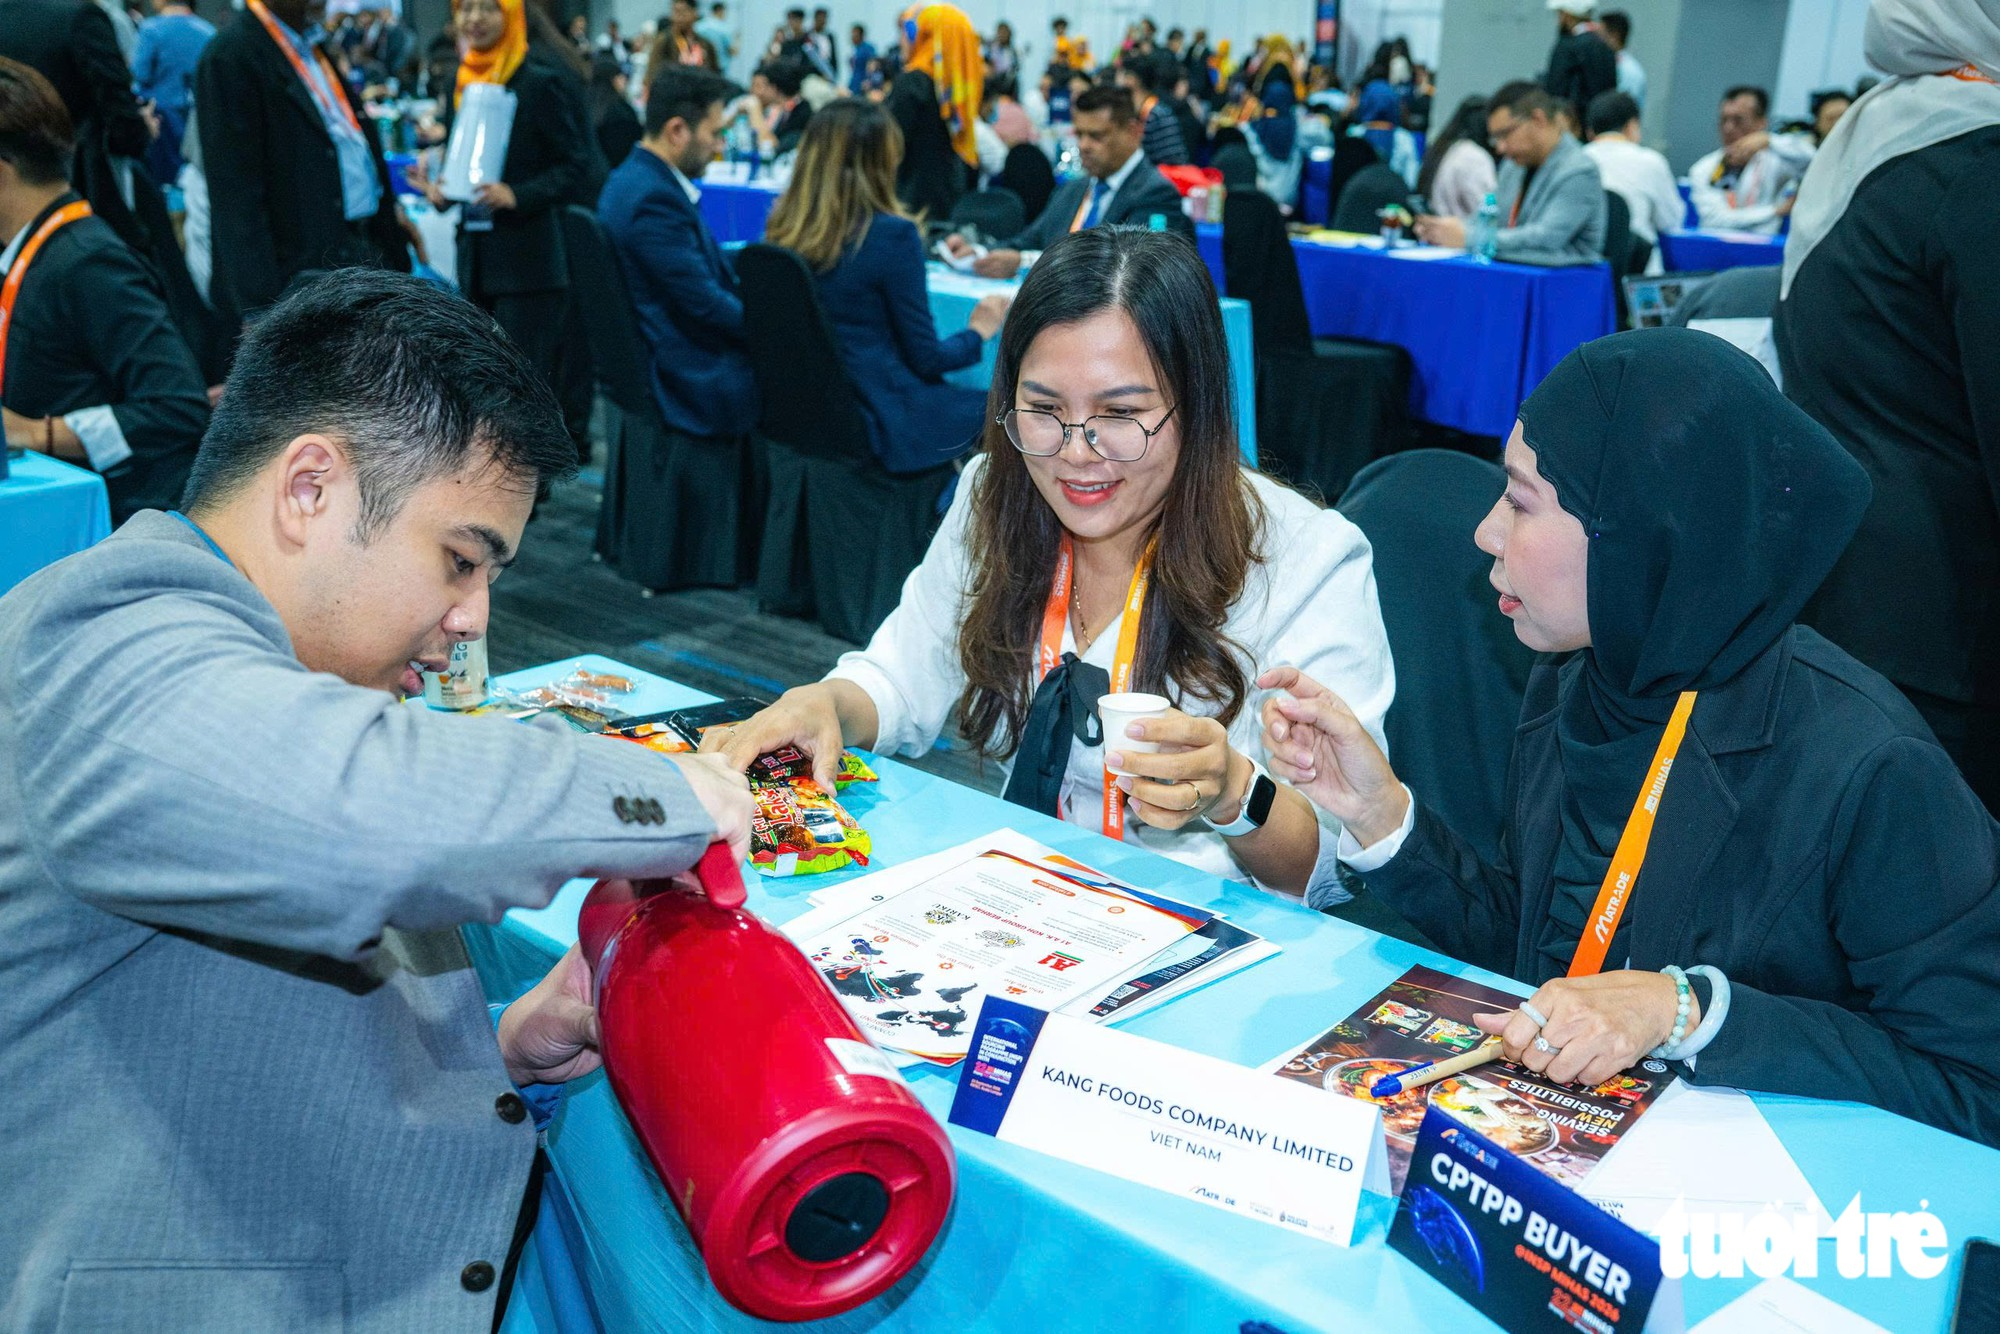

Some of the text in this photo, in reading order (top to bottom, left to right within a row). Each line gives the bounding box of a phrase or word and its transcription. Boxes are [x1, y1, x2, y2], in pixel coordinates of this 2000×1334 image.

[1116, 663, 1128, 694] RADE
[1650, 757, 1674, 798] MIHAS
[1109, 780, 1118, 815] MIHAS
[968, 905, 1002, 920] BERHAD
[998, 917, 1028, 930] GROUP
[1595, 871, 1630, 944] MATRADE
[1036, 953, 1078, 974] A1
[1508, 1080, 1625, 1121] POSSIBILITIES
[1042, 1066, 1093, 1093] KANG
[1098, 1082, 1163, 1115] FOODS
[1169, 1105, 1267, 1146] COMPANY
[1273, 1136, 1354, 1173] LIMITED
[1536, 1108, 1611, 1137] SERVING
[1574, 1112, 1618, 1130] NEW
[1150, 1130, 1222, 1163] VIET NAM
[1190, 1185, 1236, 1206] MATRDE
[1431, 1153, 1632, 1306] CPTPP BUYER
